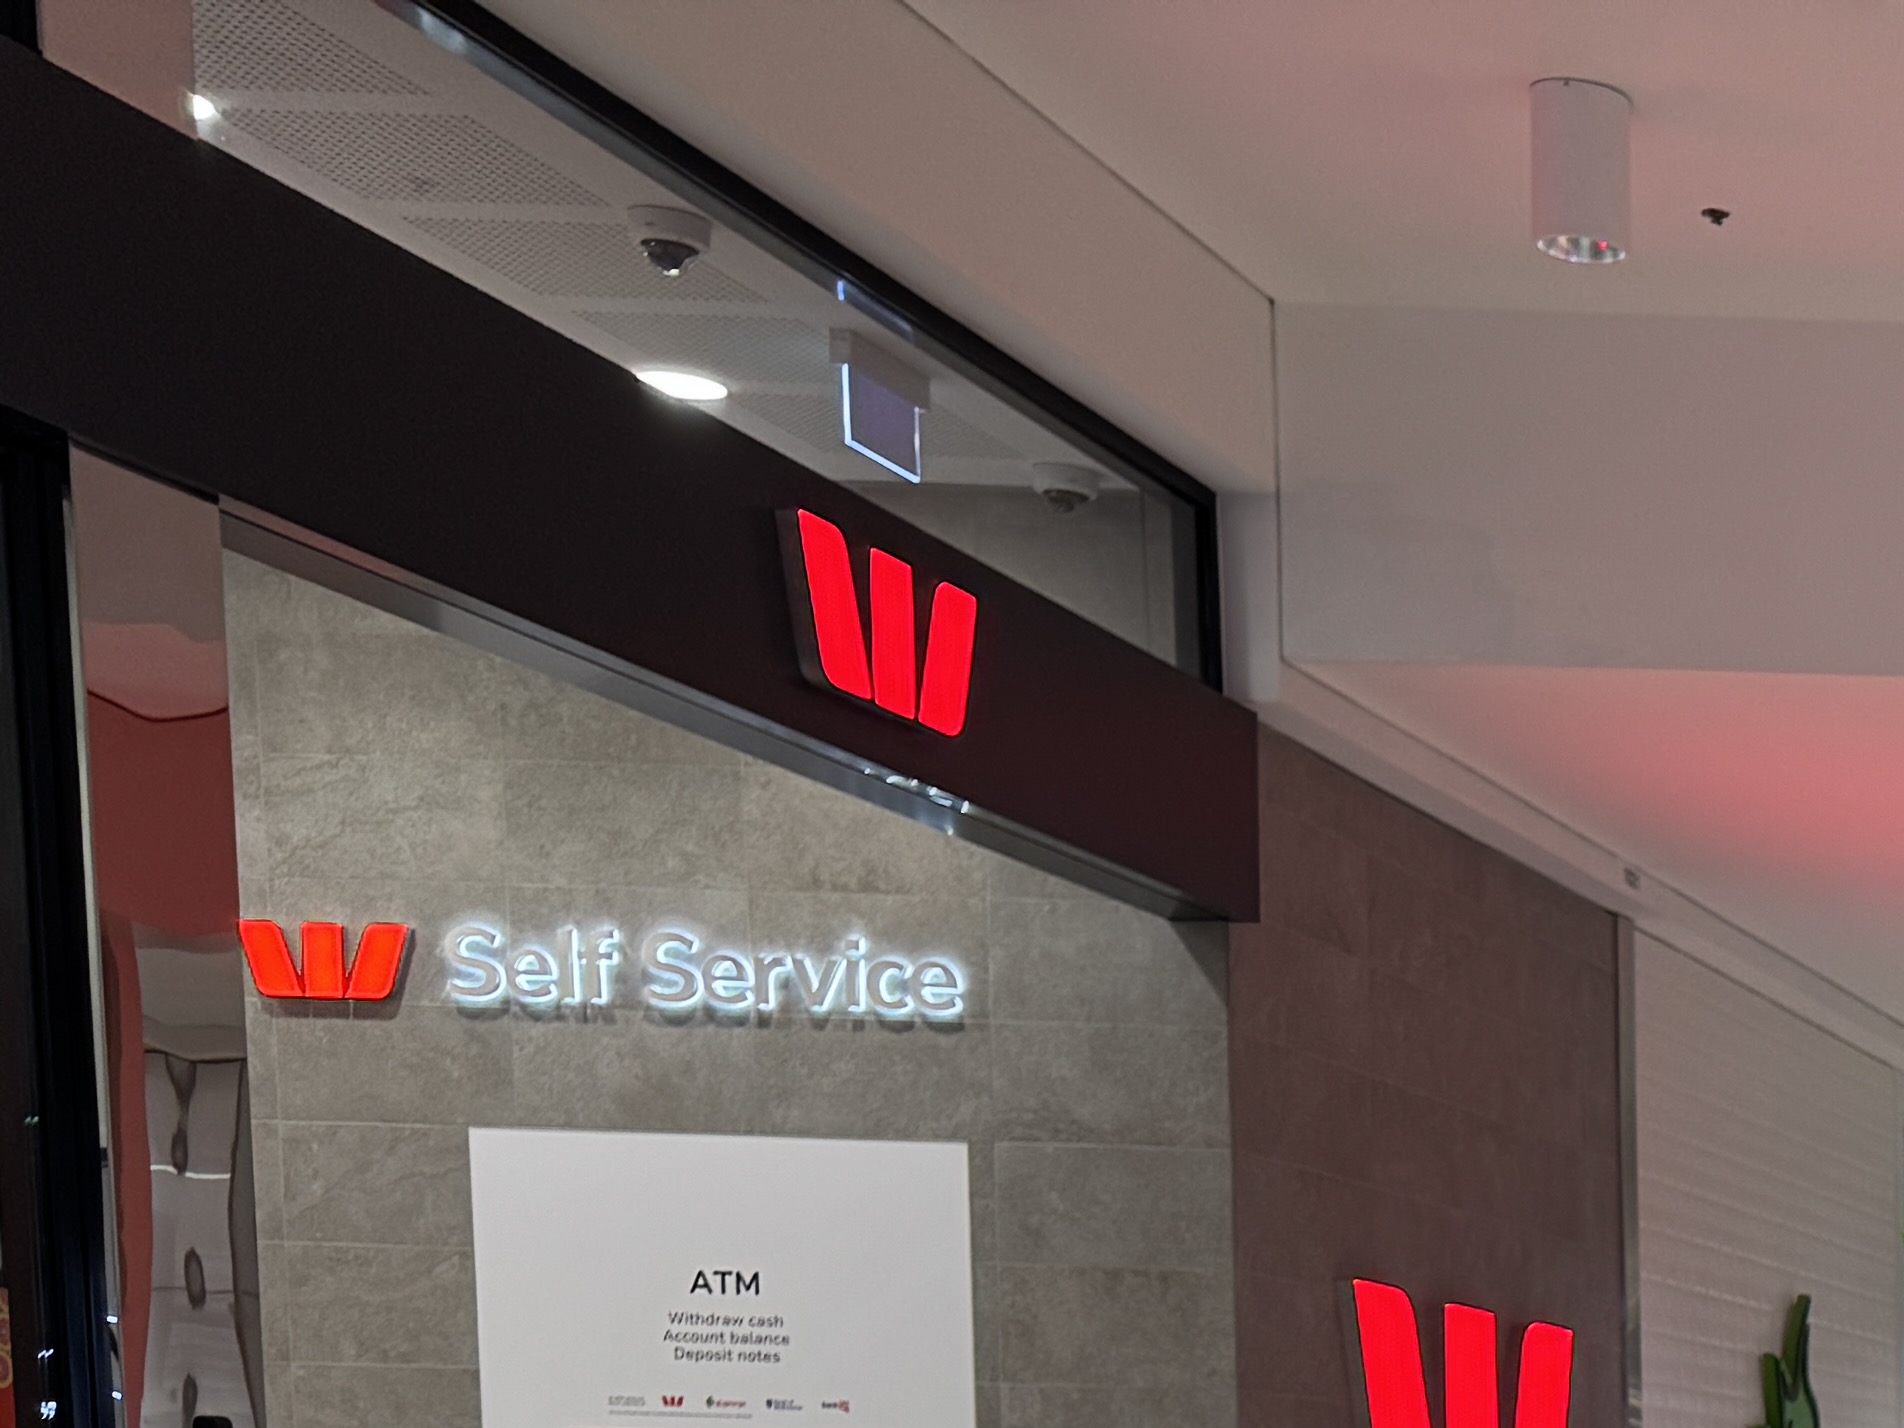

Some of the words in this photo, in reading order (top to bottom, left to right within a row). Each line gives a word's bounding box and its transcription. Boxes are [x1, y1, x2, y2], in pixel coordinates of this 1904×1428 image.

[448, 922, 620, 1007] Self
[645, 927, 965, 1017] Service
[690, 1269, 761, 1296] ATM
[668, 1311, 743, 1328] Withdraw
[748, 1314, 784, 1329] cash
[664, 1329, 725, 1344] Account
[729, 1330, 790, 1346] balance
[674, 1346, 734, 1364] Deposit
[737, 1348, 781, 1363] notes
